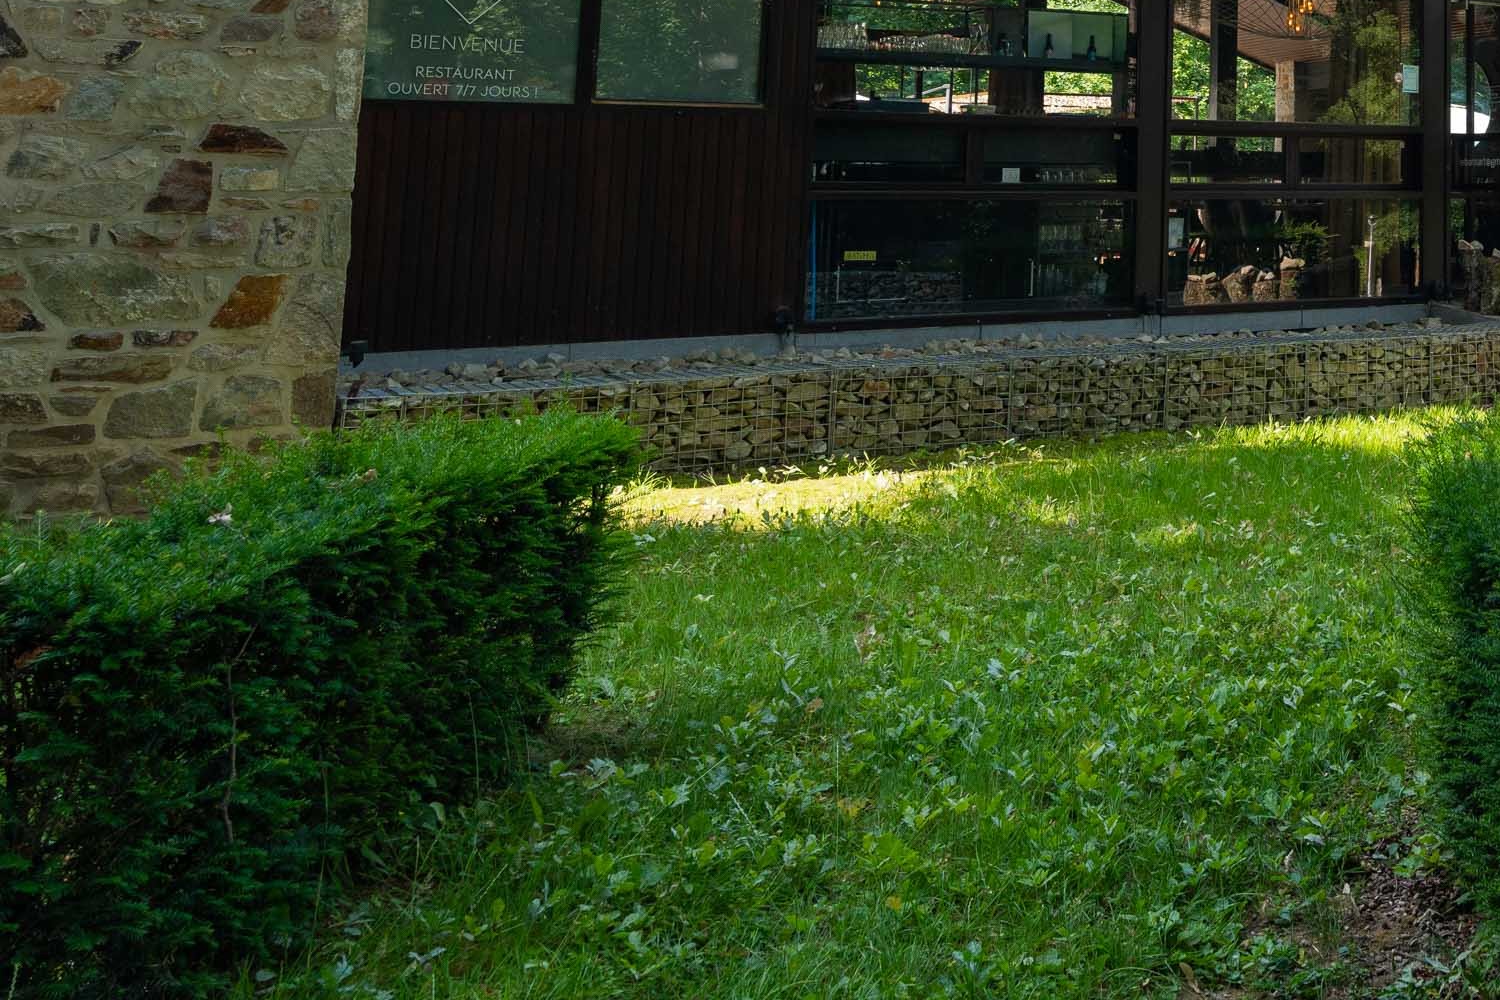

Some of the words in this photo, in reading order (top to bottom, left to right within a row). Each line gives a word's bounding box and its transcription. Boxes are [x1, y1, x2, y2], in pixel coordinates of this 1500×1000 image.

[410, 33, 526, 54] BIENVENUE
[415, 65, 516, 81] RESTAURANT
[387, 82, 453, 96] OUVERT
[455, 84, 476, 96] 7/7
[480, 85, 530, 98] JOURS
